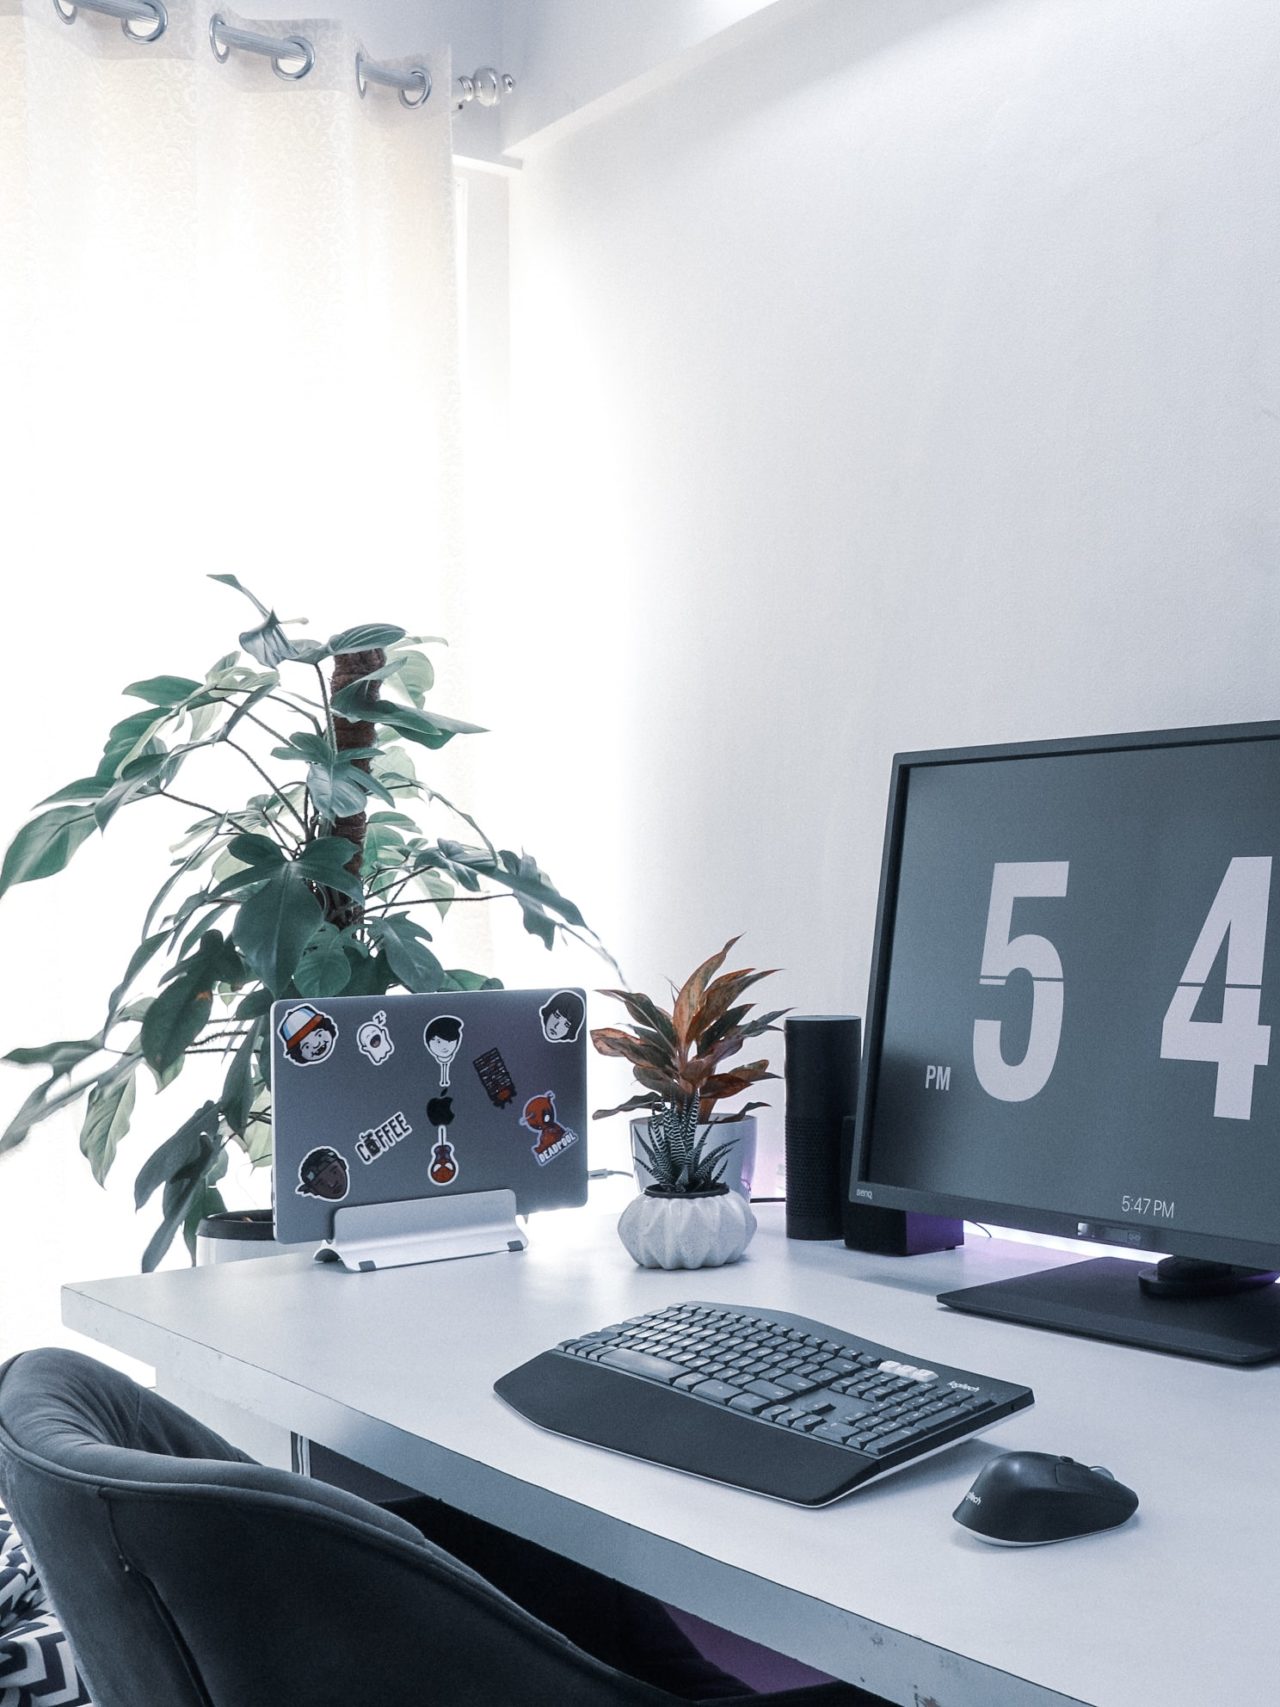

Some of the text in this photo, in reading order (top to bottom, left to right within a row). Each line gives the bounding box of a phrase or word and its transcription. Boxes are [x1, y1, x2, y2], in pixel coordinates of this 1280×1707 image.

[973, 861, 1070, 1103] 5
[926, 1065, 951, 1091] PM
[538, 1132, 576, 1163] DEADPOOL
[1122, 1195, 1175, 1219] 5:47 PM
